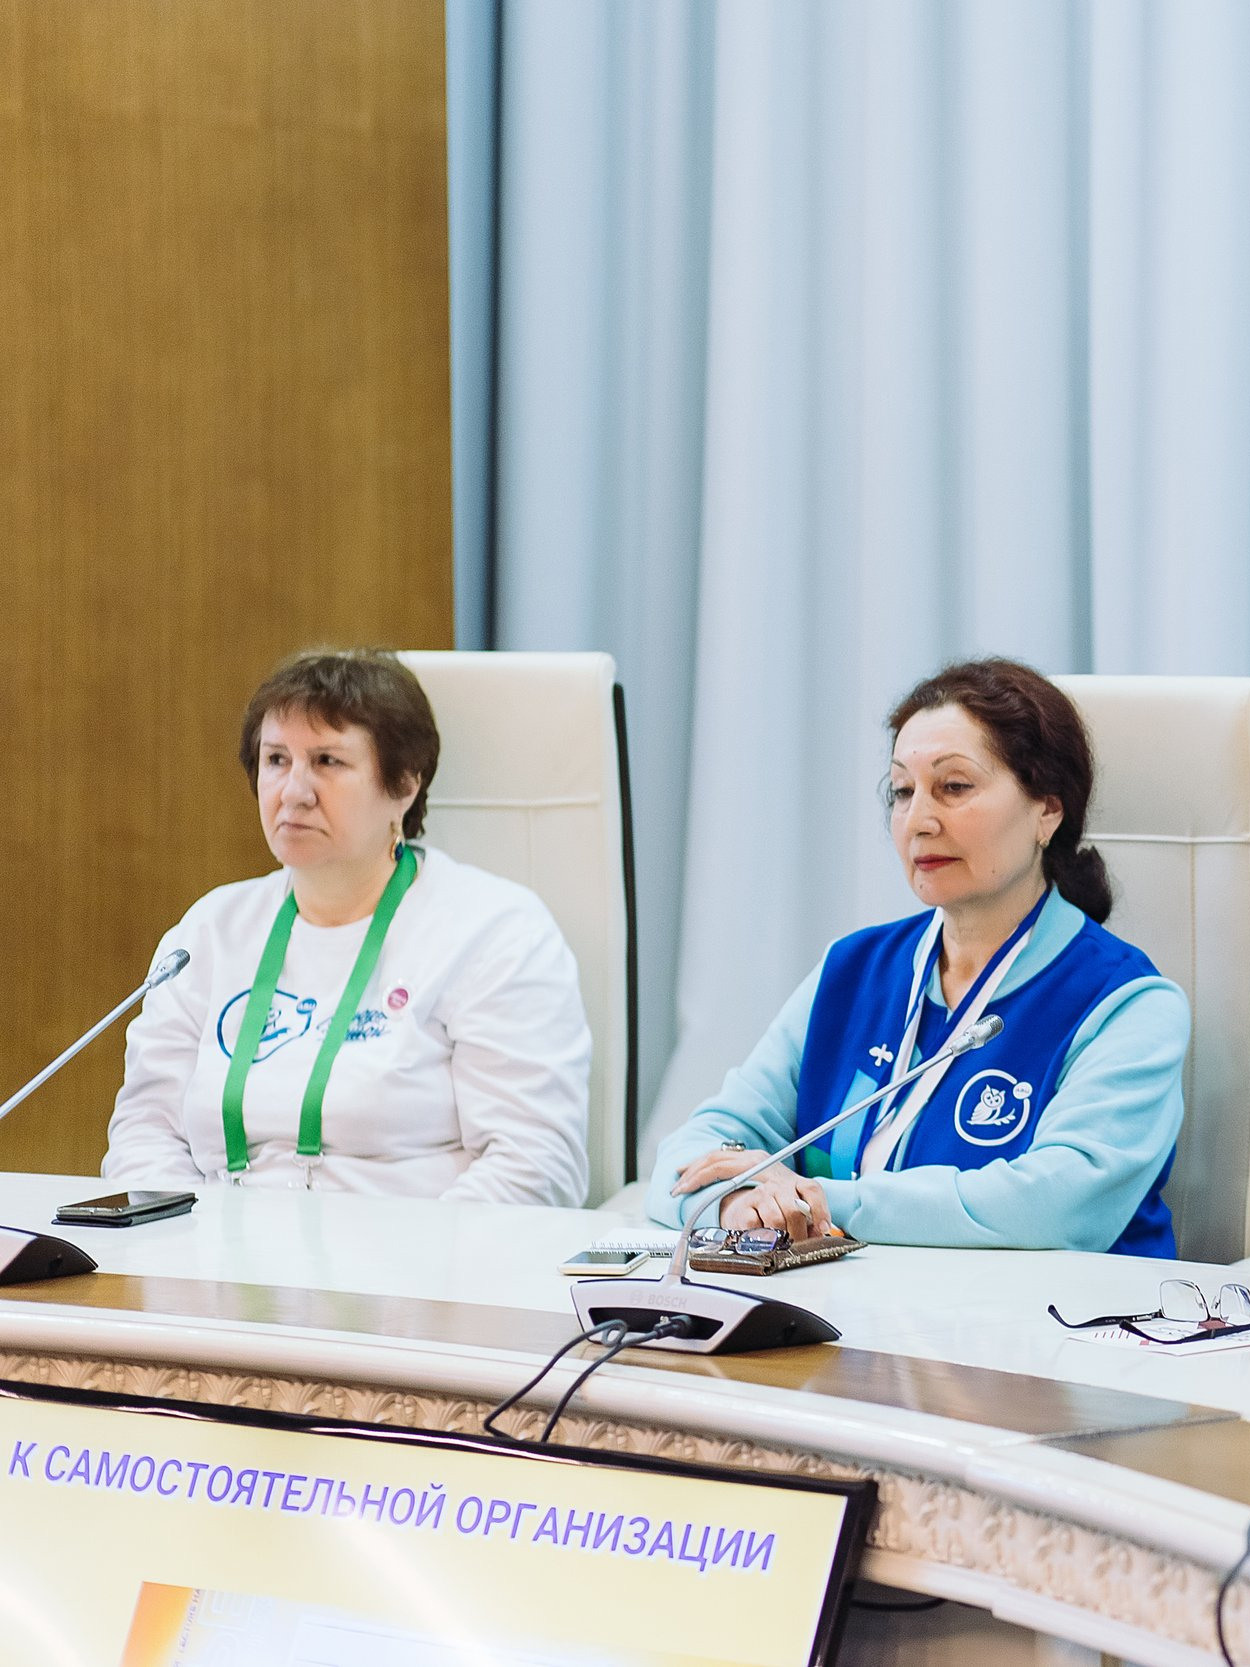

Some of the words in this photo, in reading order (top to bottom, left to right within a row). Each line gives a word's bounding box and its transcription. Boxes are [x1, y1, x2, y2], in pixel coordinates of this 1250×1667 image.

[648, 1294, 687, 1308] BOSCH
[8, 1440, 38, 1477] К
[44, 1444, 446, 1530] САМОСТОЯТЕЛЬНОЙ
[455, 1495, 776, 1572] ОРГАНИЗАЦИИ
